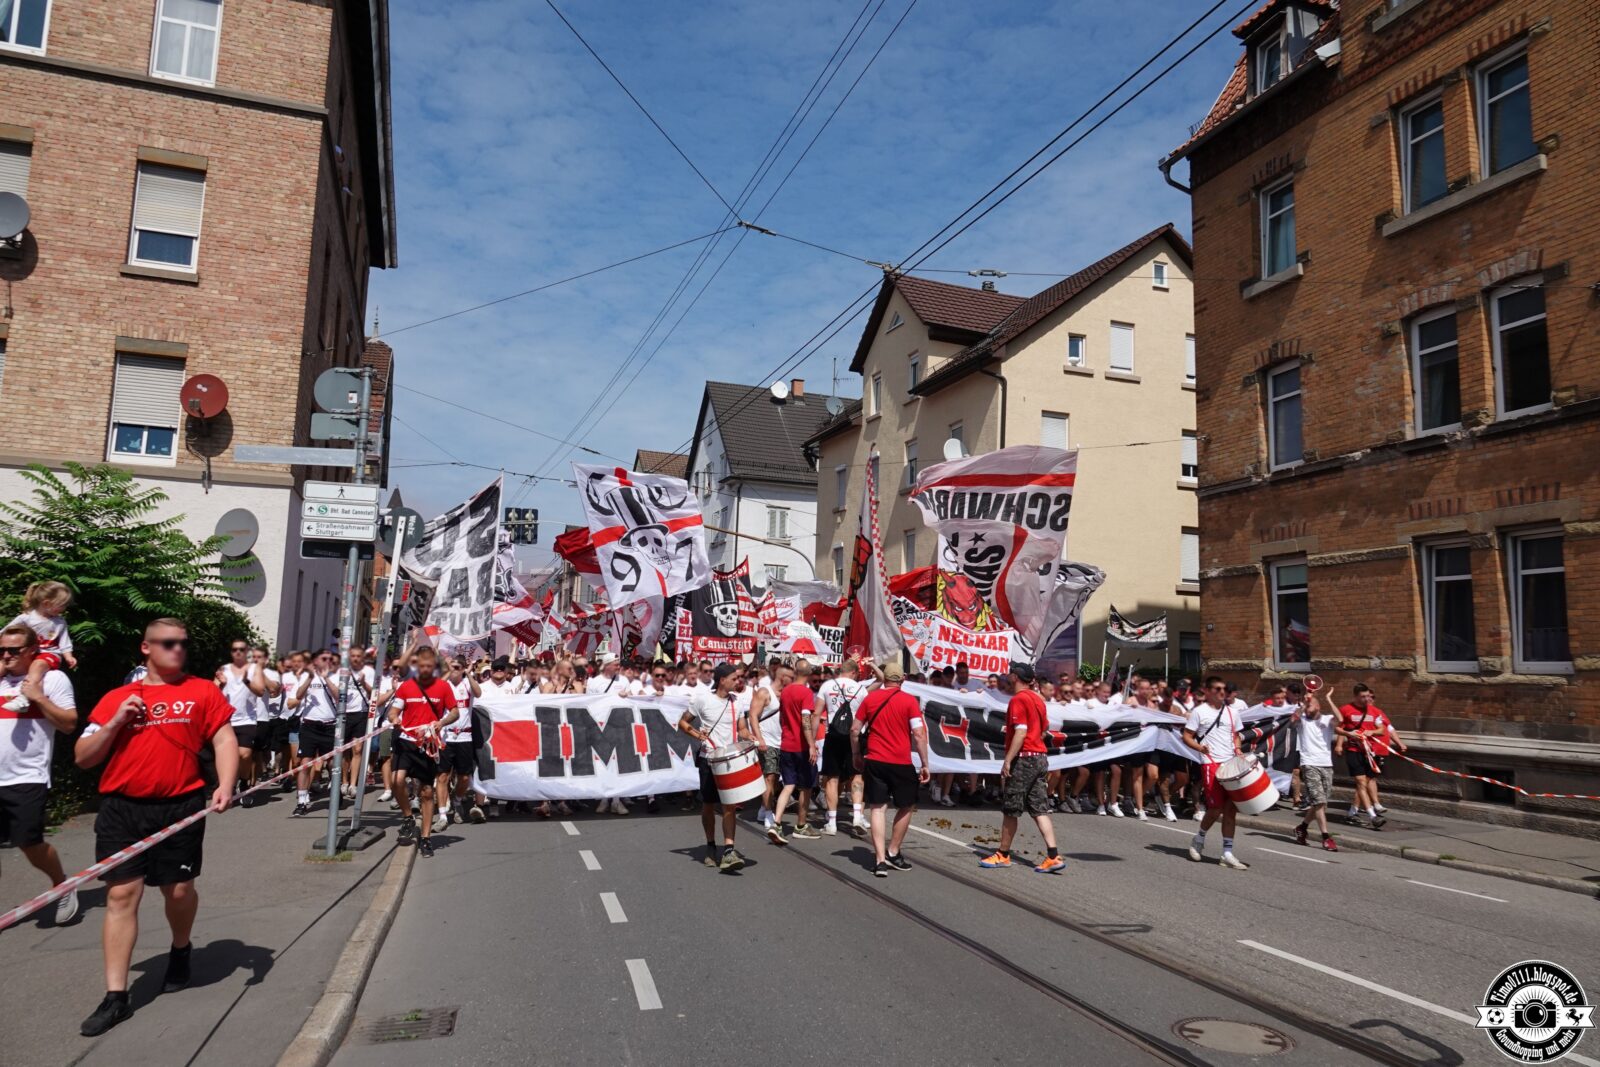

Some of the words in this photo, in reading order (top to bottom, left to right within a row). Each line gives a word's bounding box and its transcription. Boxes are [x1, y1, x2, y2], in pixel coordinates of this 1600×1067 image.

[315, 528, 344, 537] Stuttgart
[697, 636, 753, 651] Cannstatt
[938, 624, 1009, 653] NECKAR
[931, 645, 1010, 675] STADION
[172, 700, 196, 715] 97
